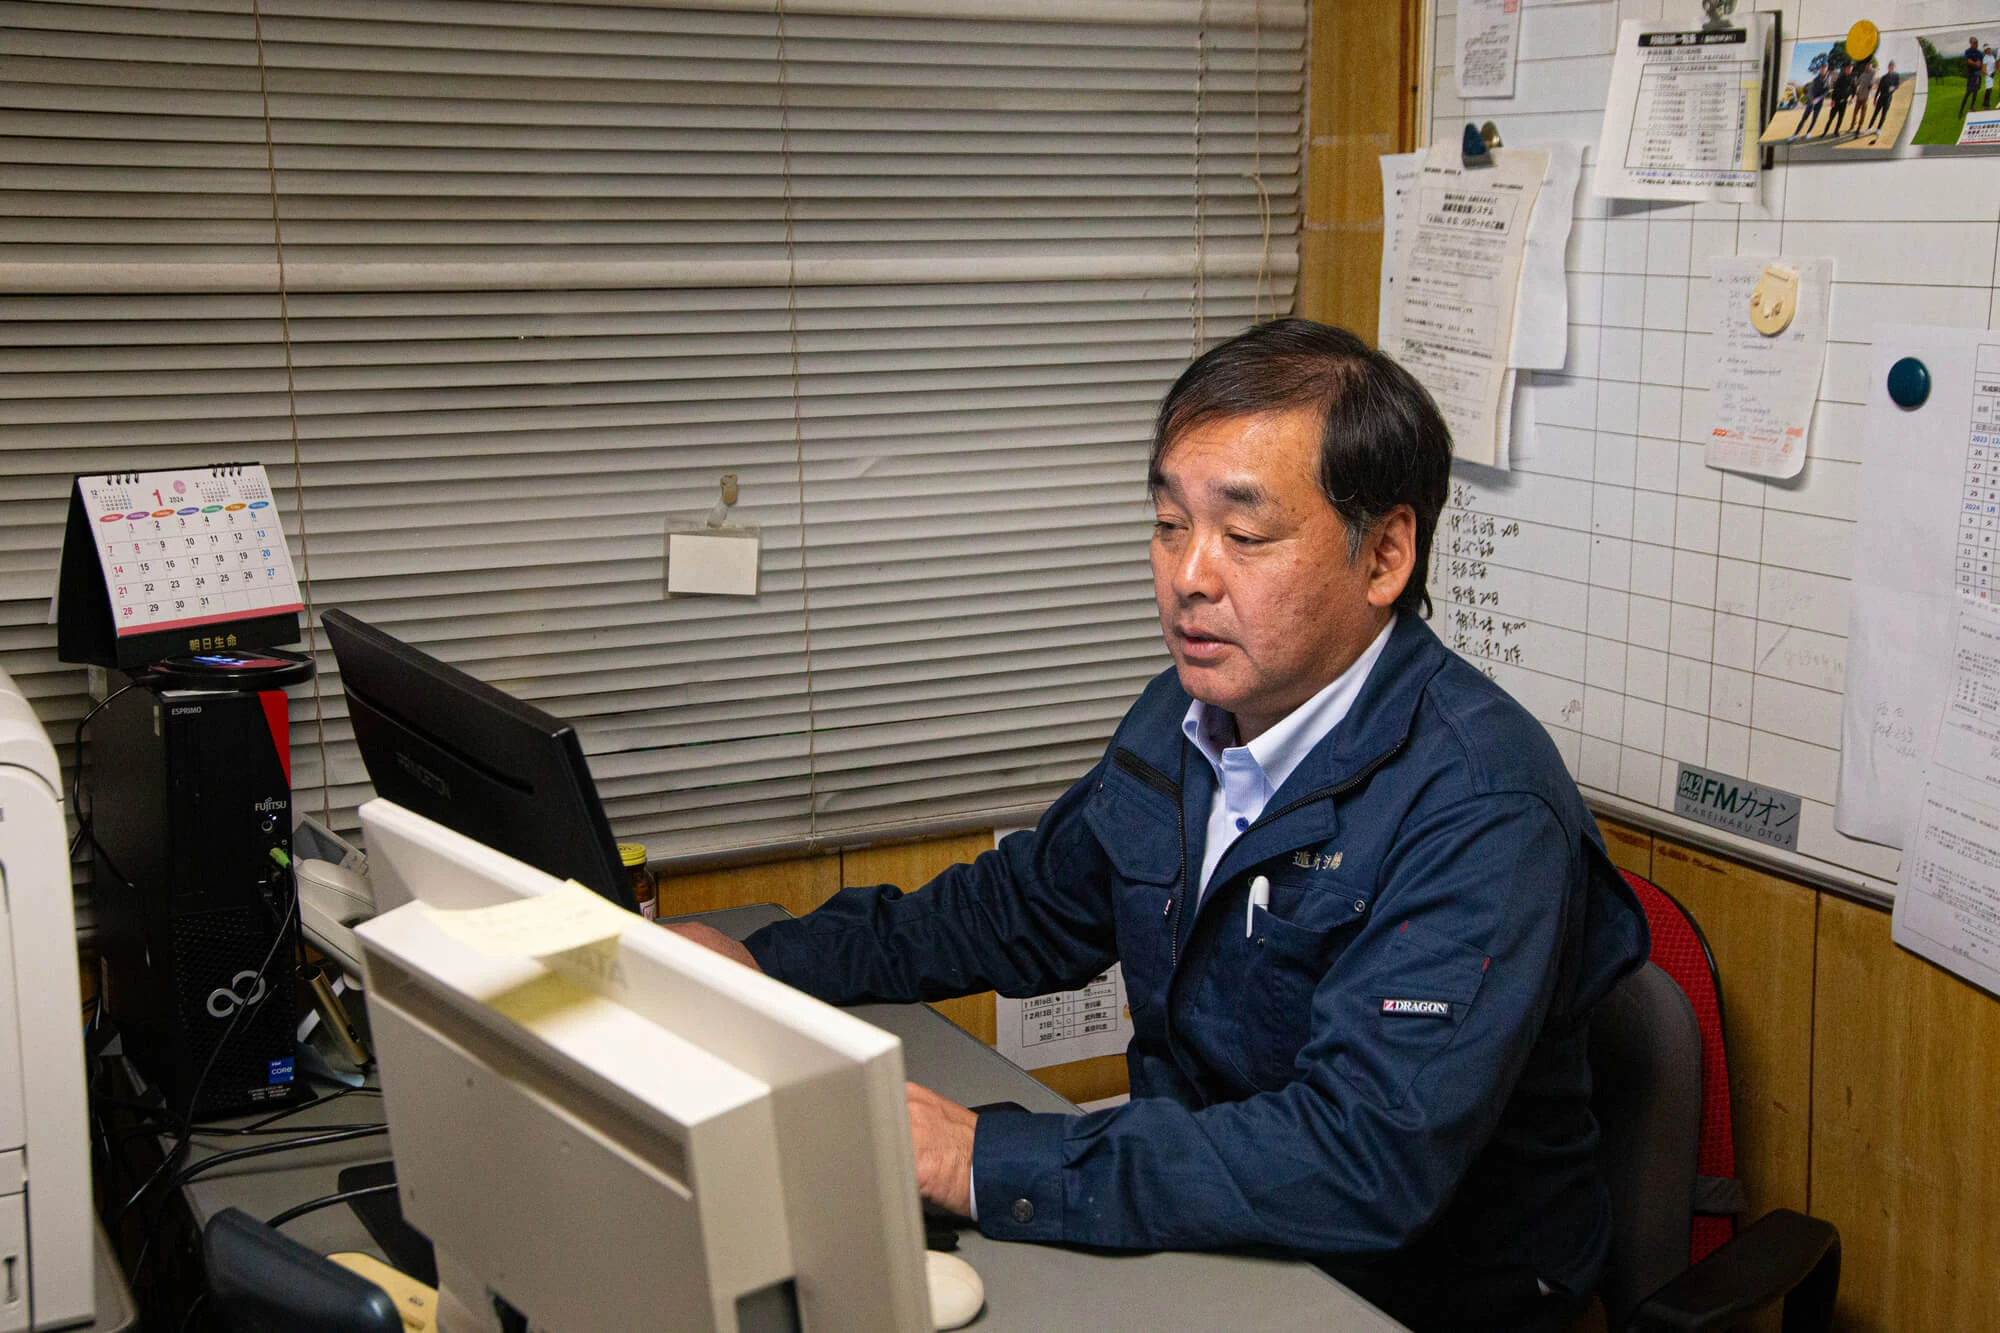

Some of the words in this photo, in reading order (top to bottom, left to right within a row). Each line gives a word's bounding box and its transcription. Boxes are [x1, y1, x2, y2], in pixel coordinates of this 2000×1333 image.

[152, 489, 163, 506] 1
[180, 518, 185, 526] 3
[140, 563, 149, 571] 15
[166, 560, 175, 568] 16
[262, 549, 270, 557] 20
[119, 586, 128, 594] 21
[144, 584, 154, 592] 22
[244, 571, 253, 579] 26
[267, 568, 275, 576] 27
[200, 597, 209, 605] 31
[172, 706, 202, 715] ESPRIMO
[255, 797, 286, 812] FUJITSU
